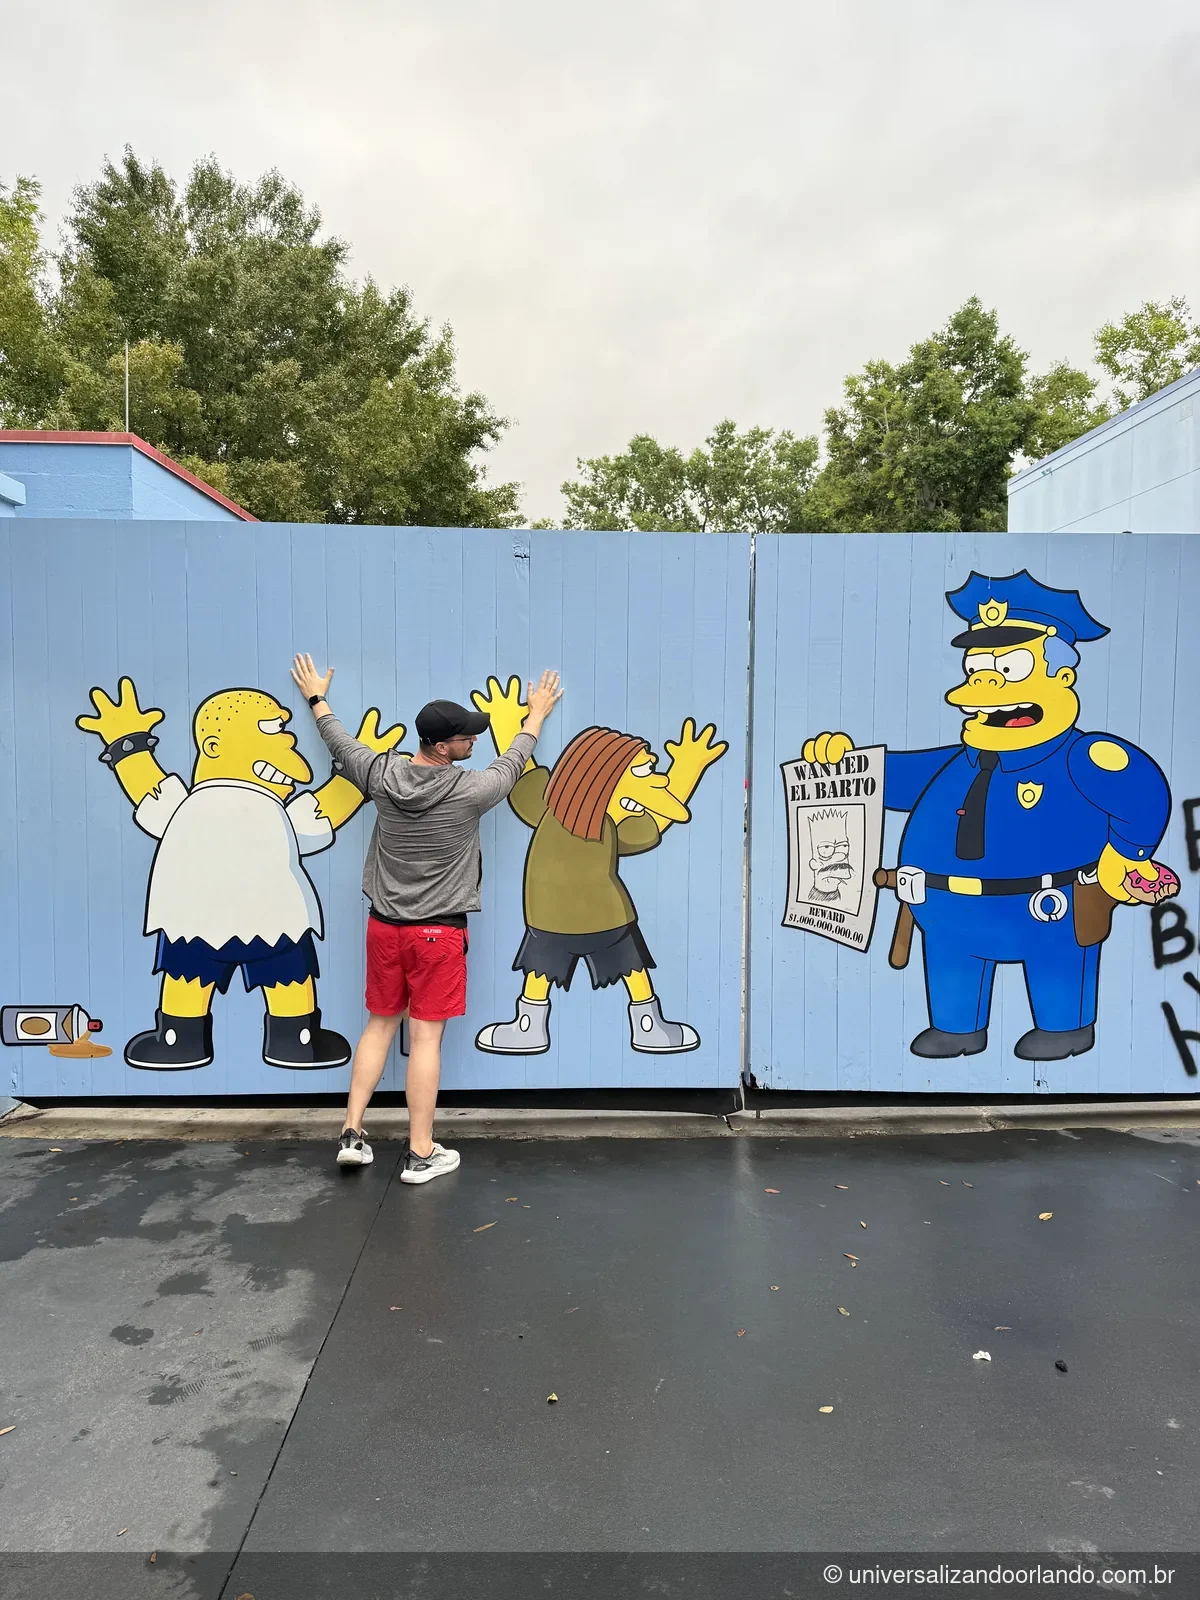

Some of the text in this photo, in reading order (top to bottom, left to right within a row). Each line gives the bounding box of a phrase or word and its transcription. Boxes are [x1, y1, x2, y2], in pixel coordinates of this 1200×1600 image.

[793, 754, 870, 781] WANTED
[790, 776, 877, 802] EL BARTO
[808, 906, 846, 924] REWARD
[1150, 902, 1200, 969] B
